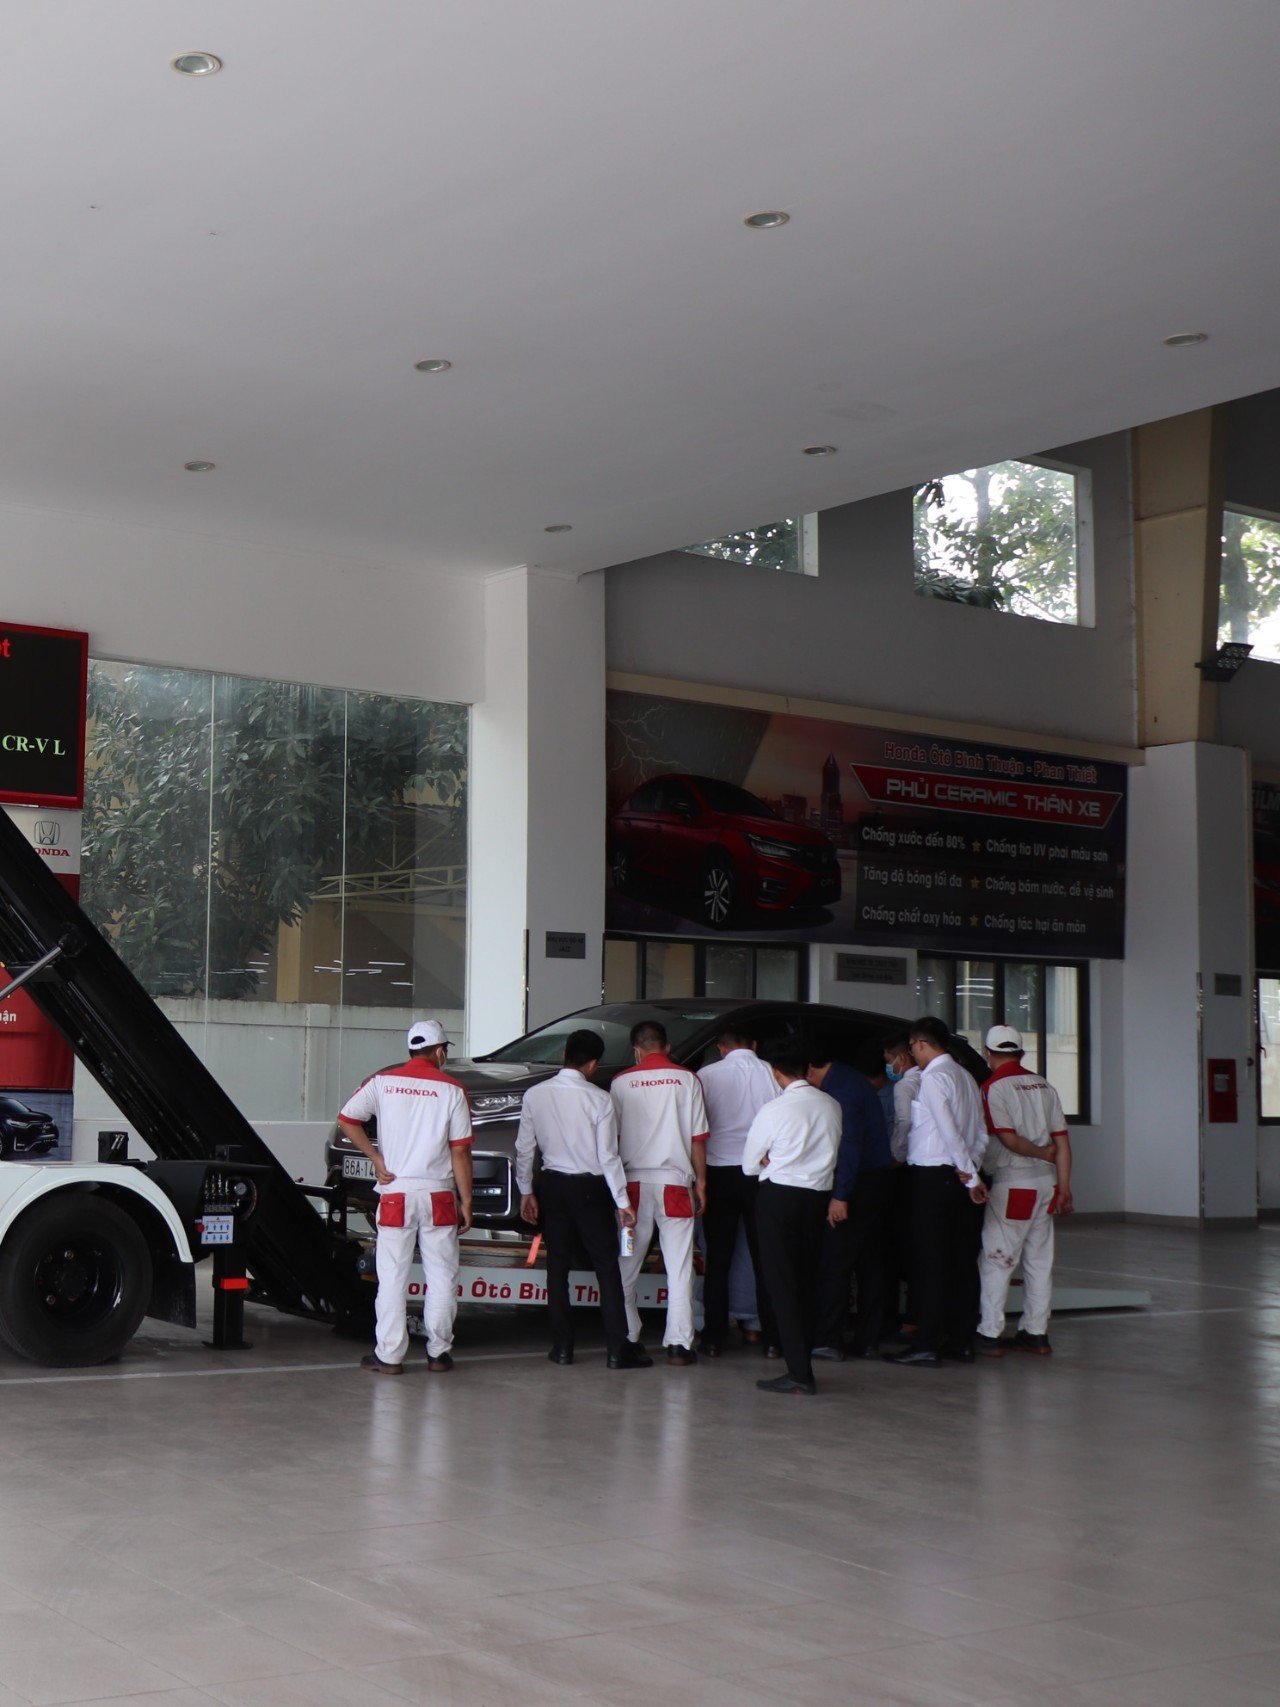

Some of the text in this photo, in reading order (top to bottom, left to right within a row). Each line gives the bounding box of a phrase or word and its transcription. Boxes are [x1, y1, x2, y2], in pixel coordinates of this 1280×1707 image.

[2, 734, 49, 754] CR-V
[54, 740, 66, 756] L
[884, 742, 926, 761] Honda
[886, 777, 1101, 818] PHỦ CERAMIC THÂN XE
[862, 825, 896, 847] Chống
[925, 831, 944, 847] đến
[946, 835, 966, 850] 80%
[986, 838, 1017, 858] Chống
[1033, 843, 1046, 857] UV
[33, 848, 70, 857] ONDA
[985, 876, 1016, 895] Chống
[862, 905, 896, 925] Chống
[984, 914, 1015, 933] Chống
[395, 1087, 439, 1098] HONDA
[640, 1079, 682, 1087] HONDA
[344, 1159, 376, 1177] 86A-14
[471, 1276, 511, 1299] Ôtô
[519, 1282, 549, 1300] Bìn
